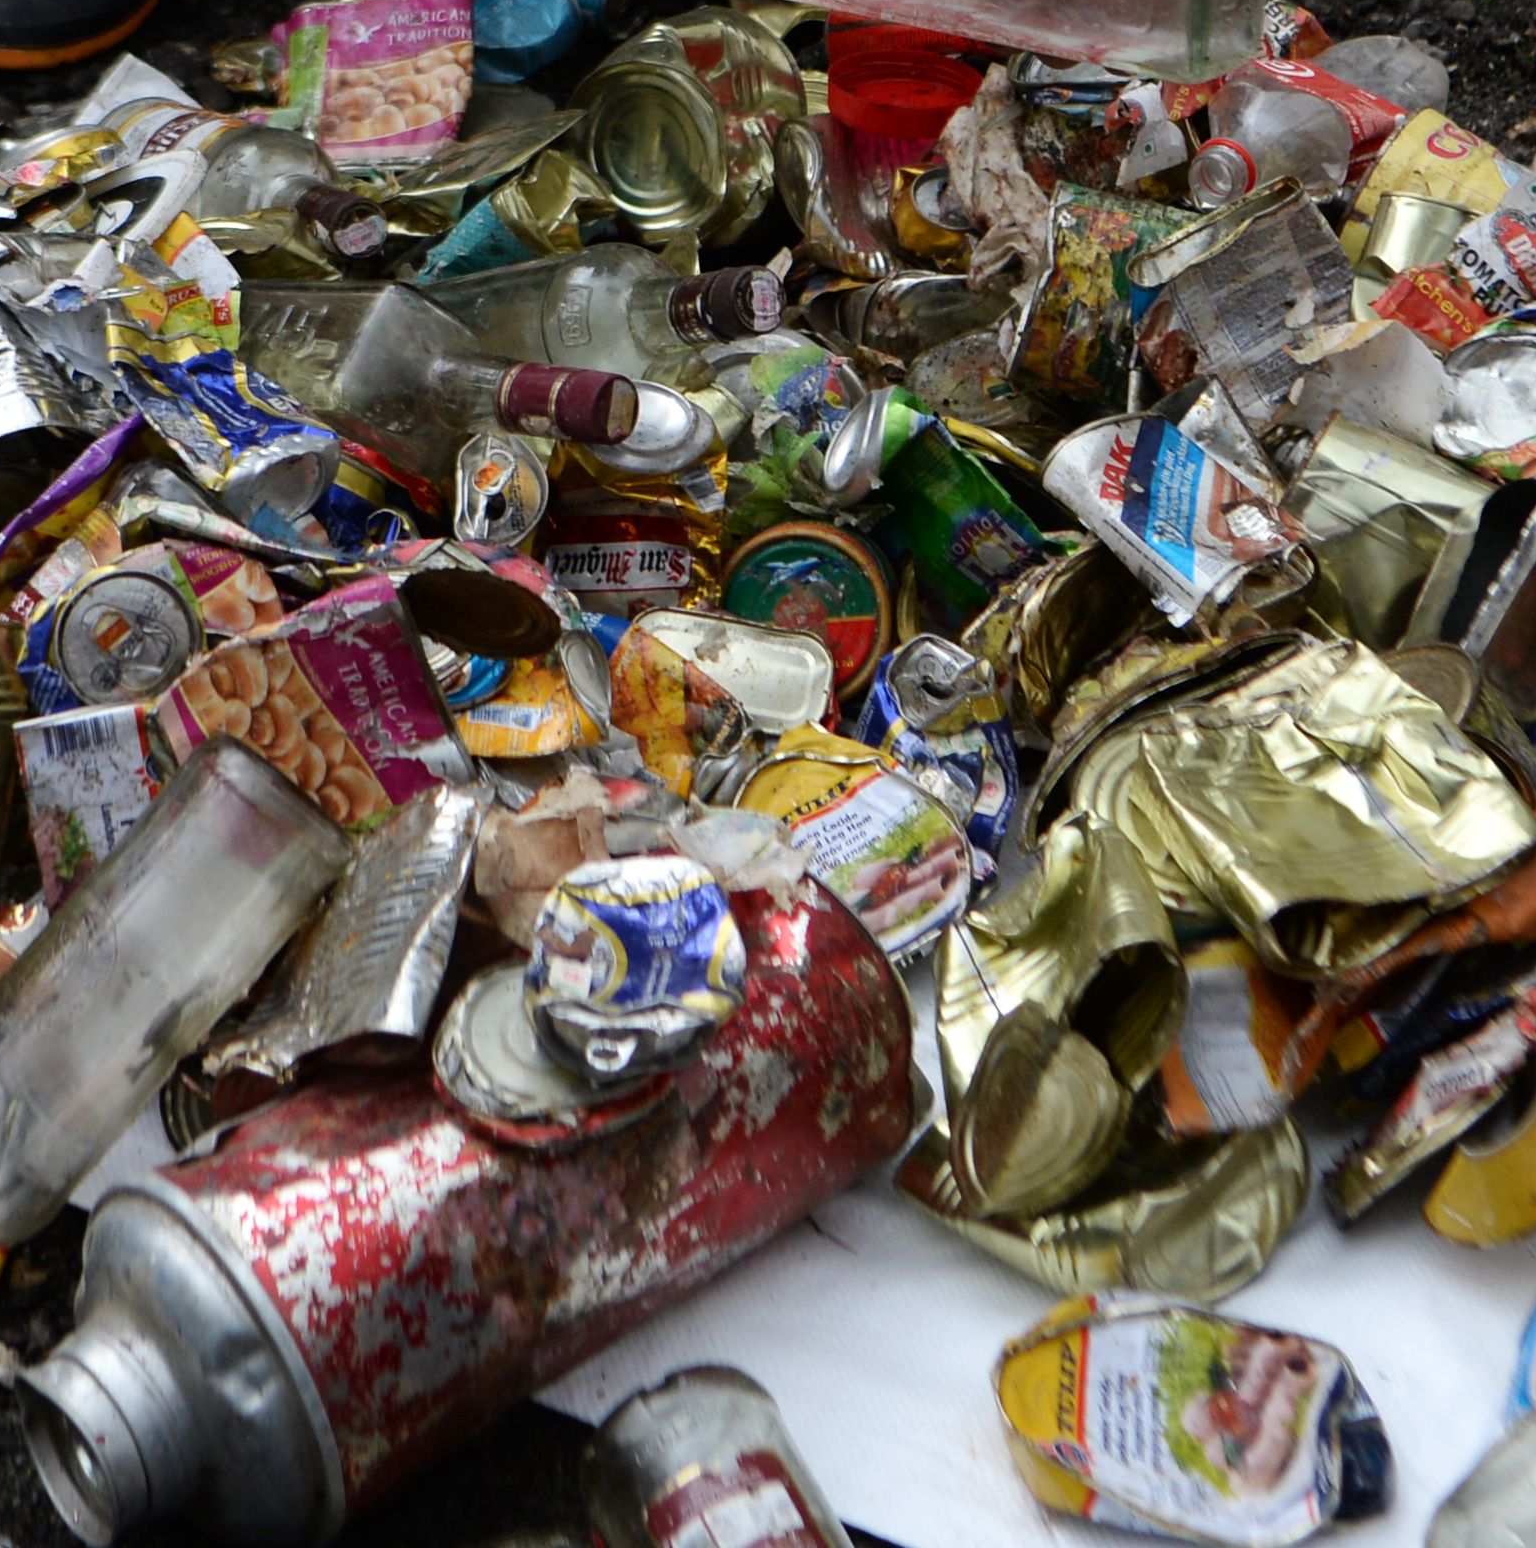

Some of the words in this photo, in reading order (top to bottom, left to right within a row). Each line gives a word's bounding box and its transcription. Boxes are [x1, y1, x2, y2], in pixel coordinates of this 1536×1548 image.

[386, 26, 472, 46] TRADITION
[1099, 433, 1136, 501] DAK
[190, 553, 243, 583] USHROOMS
[552, 545, 637, 584] Miguel
[638, 549, 687, 584] San
[1056, 1341, 1079, 1437] TULIP
